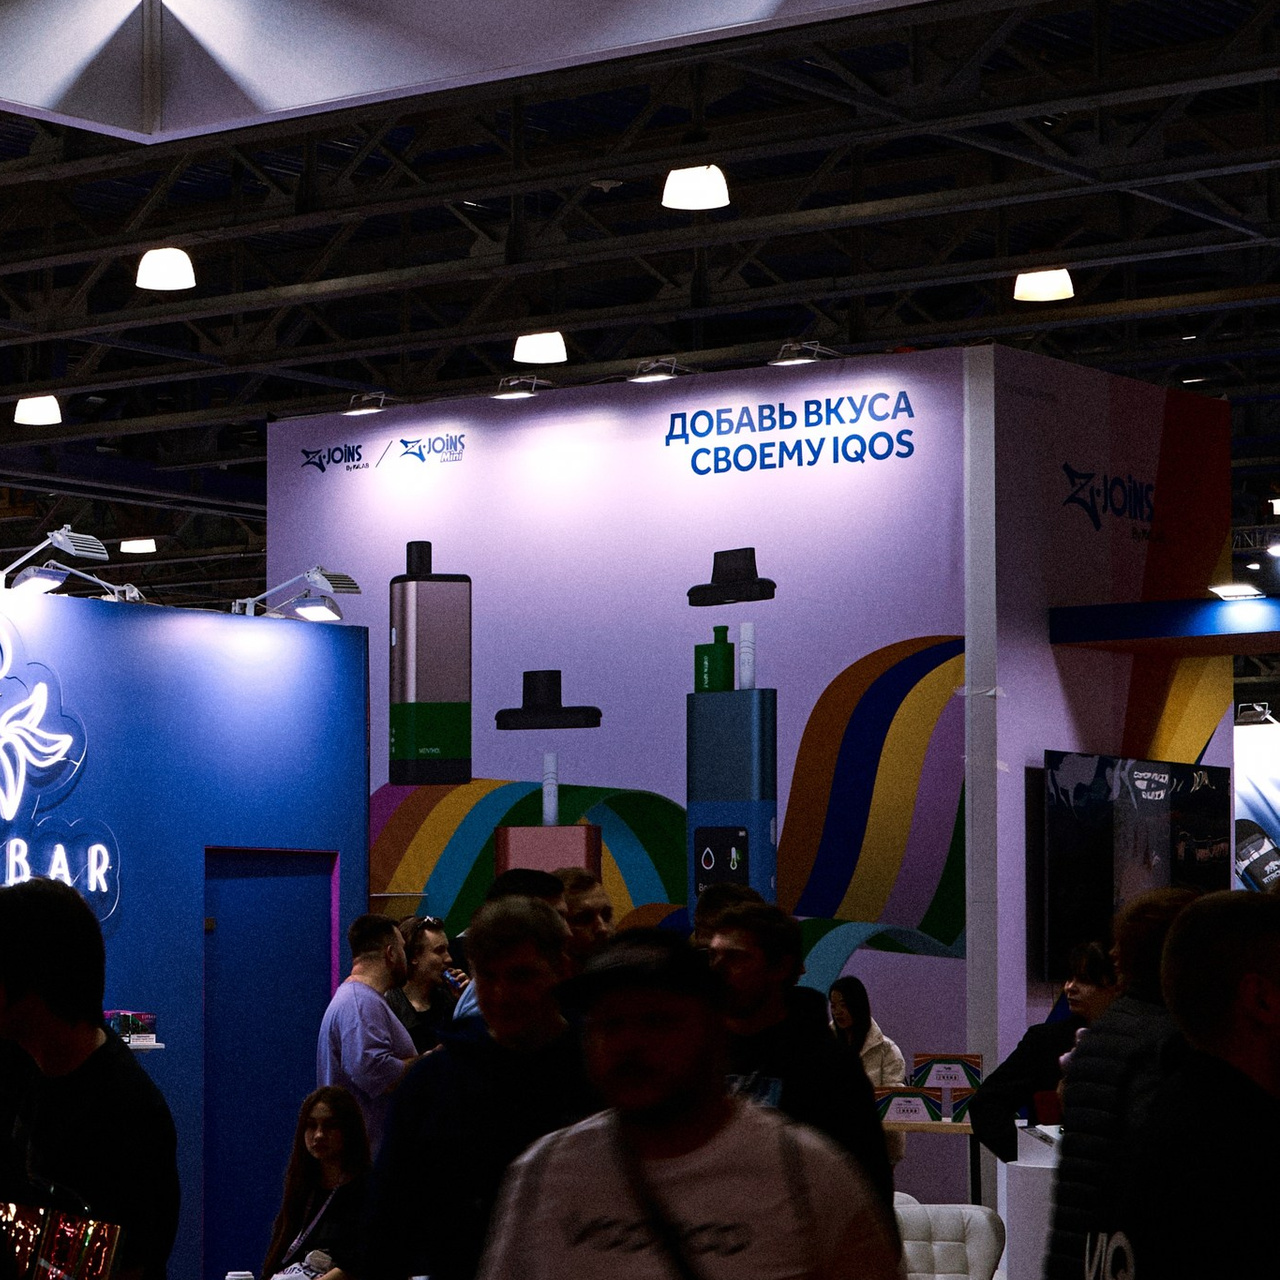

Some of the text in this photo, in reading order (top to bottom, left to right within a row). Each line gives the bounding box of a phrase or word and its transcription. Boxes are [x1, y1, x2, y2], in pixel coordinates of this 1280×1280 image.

[665, 390, 914, 446] ДОБАВЬ ВКУСА
[691, 429, 914, 475] СВОЕМУ IQOS
